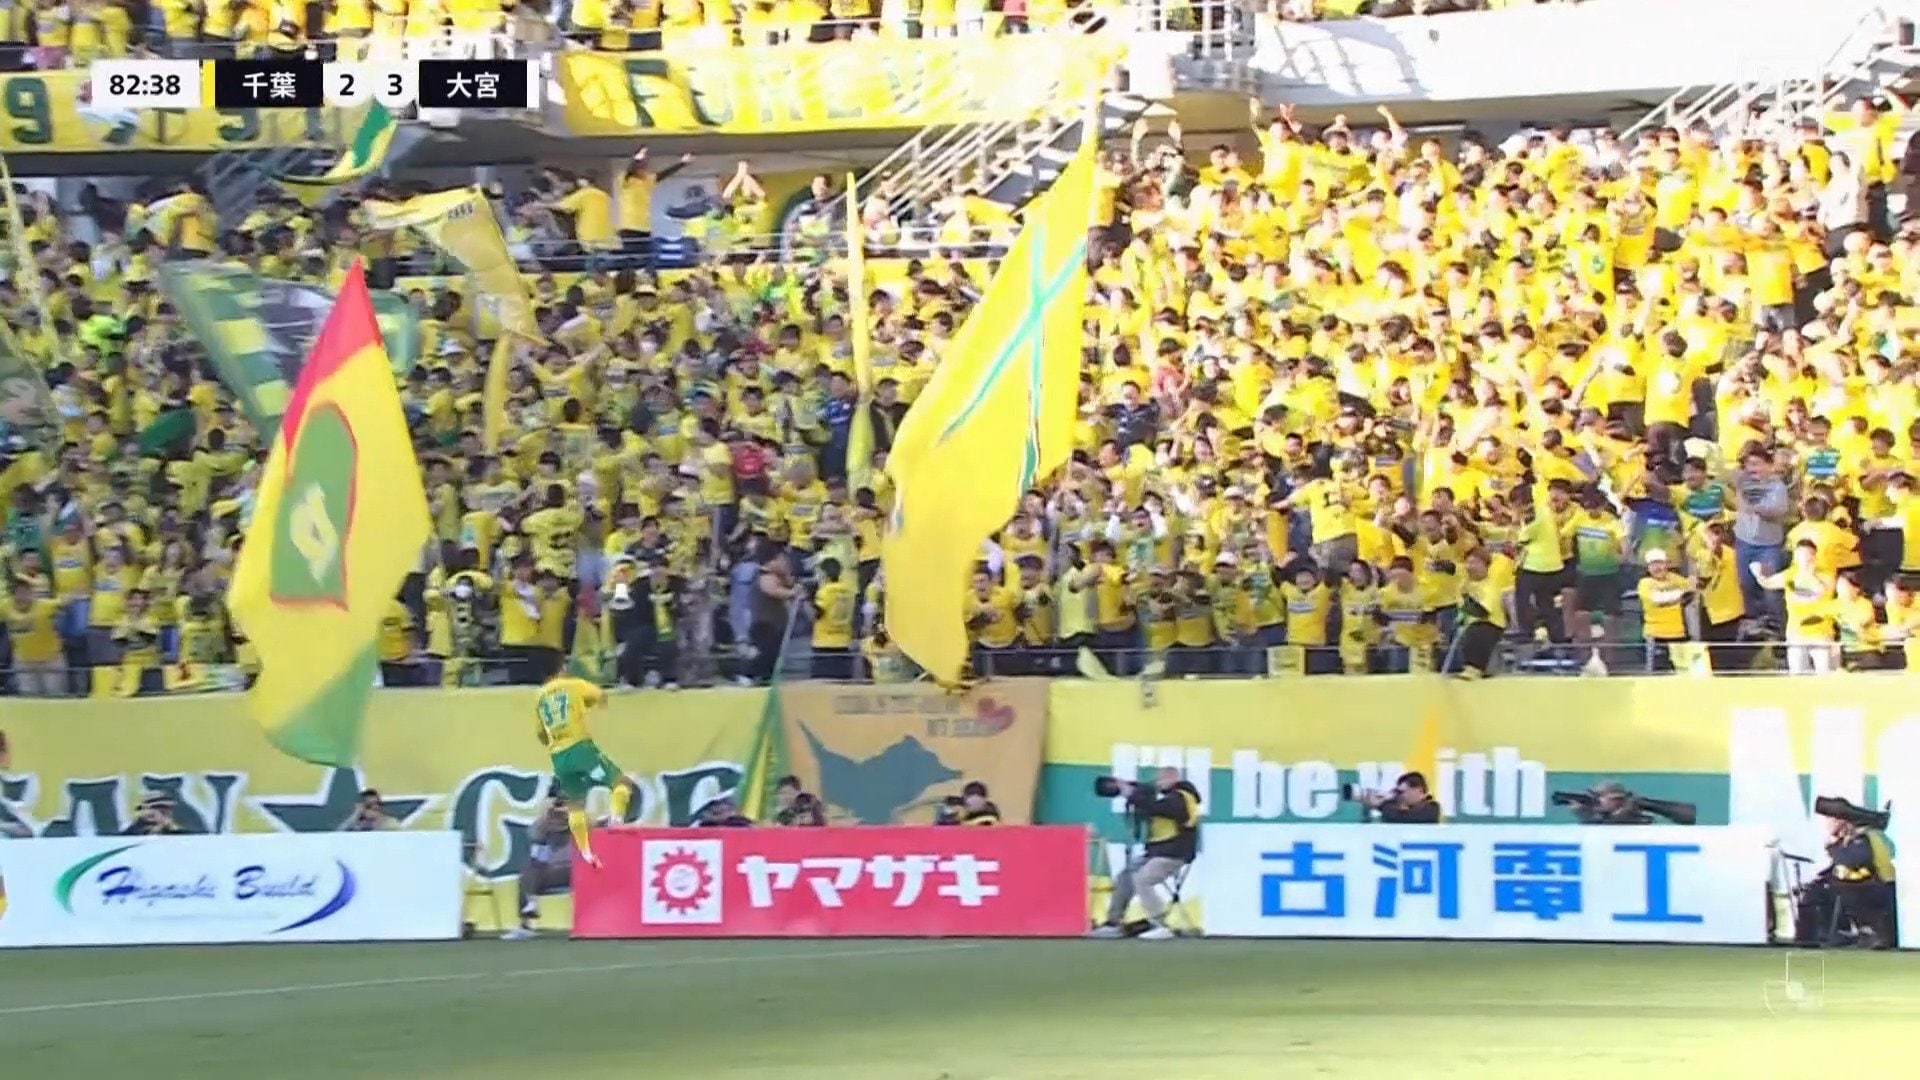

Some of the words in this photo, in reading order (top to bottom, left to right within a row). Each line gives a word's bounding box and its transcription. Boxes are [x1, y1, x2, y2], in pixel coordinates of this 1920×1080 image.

[1231, 749, 1339, 818] be
[736, 854, 1000, 908] ヤマザキ
[1260, 842, 1704, 923] 古河電工
